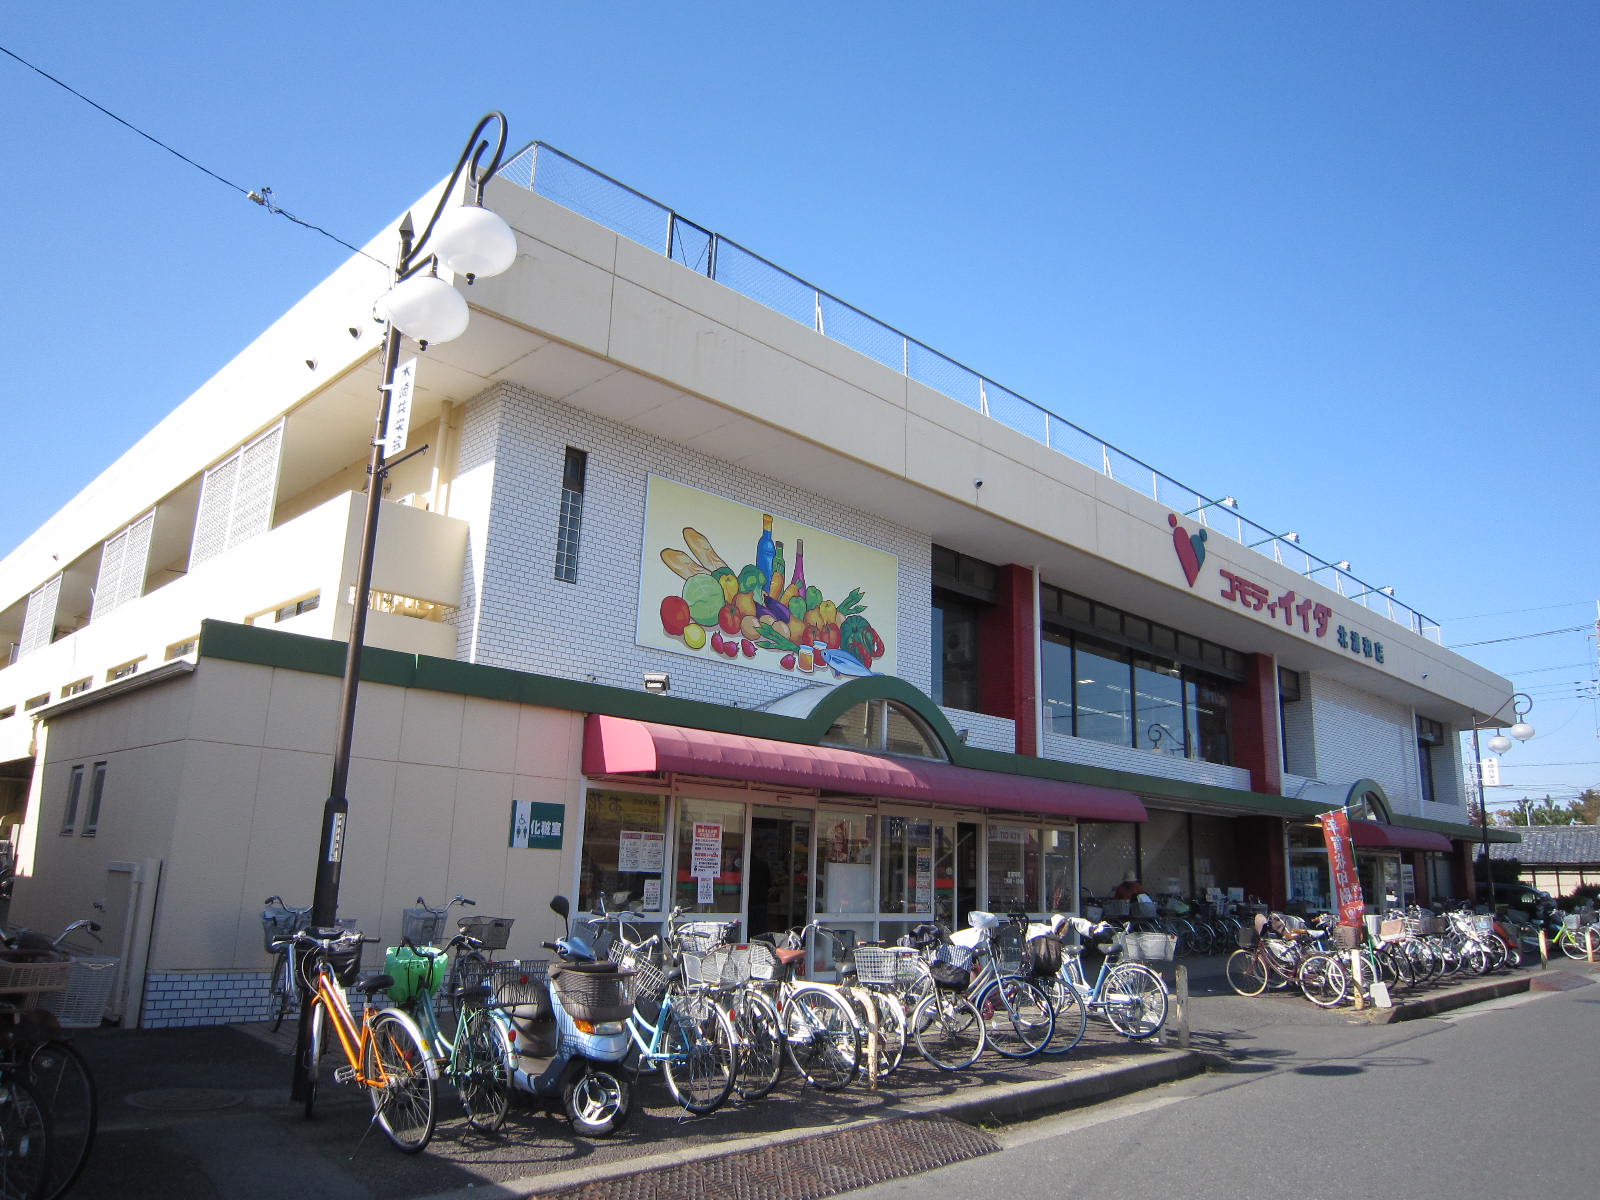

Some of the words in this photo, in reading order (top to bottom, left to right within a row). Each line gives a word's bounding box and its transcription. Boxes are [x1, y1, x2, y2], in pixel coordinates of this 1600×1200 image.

[1220, 569, 1332, 637] コモディイイダ
[1338, 625, 1384, 663] 北浦和店
[530, 819, 562, 836] 化粧室
